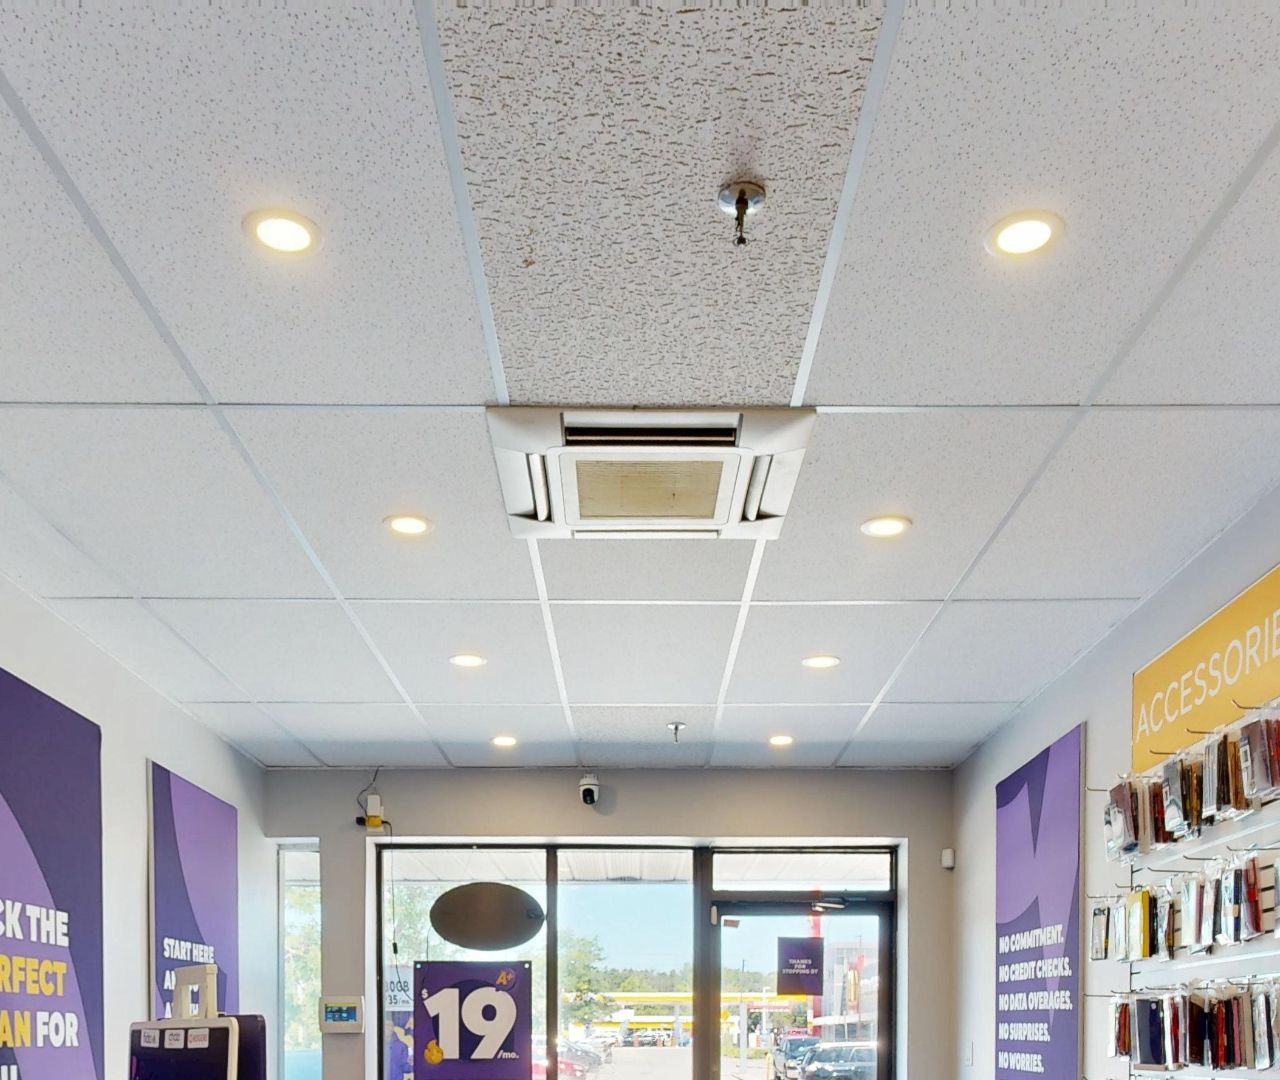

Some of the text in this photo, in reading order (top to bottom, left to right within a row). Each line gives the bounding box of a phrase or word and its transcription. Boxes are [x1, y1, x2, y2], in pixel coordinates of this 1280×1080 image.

[25, 904, 69, 947] THE
[163, 937, 214, 963] START HERE
[999, 924, 1064, 954] NO COMMITMENT.
[999, 957, 1072, 982] NO CREDIT CHECKS.
[999, 990, 1073, 1011] NO DATA OVERAGES.
[36, 1011, 79, 1047] FOR
[999, 1022, 1051, 1042] NO SURPRISES.
[999, 1051, 1044, 1073] NO WORRIES.
